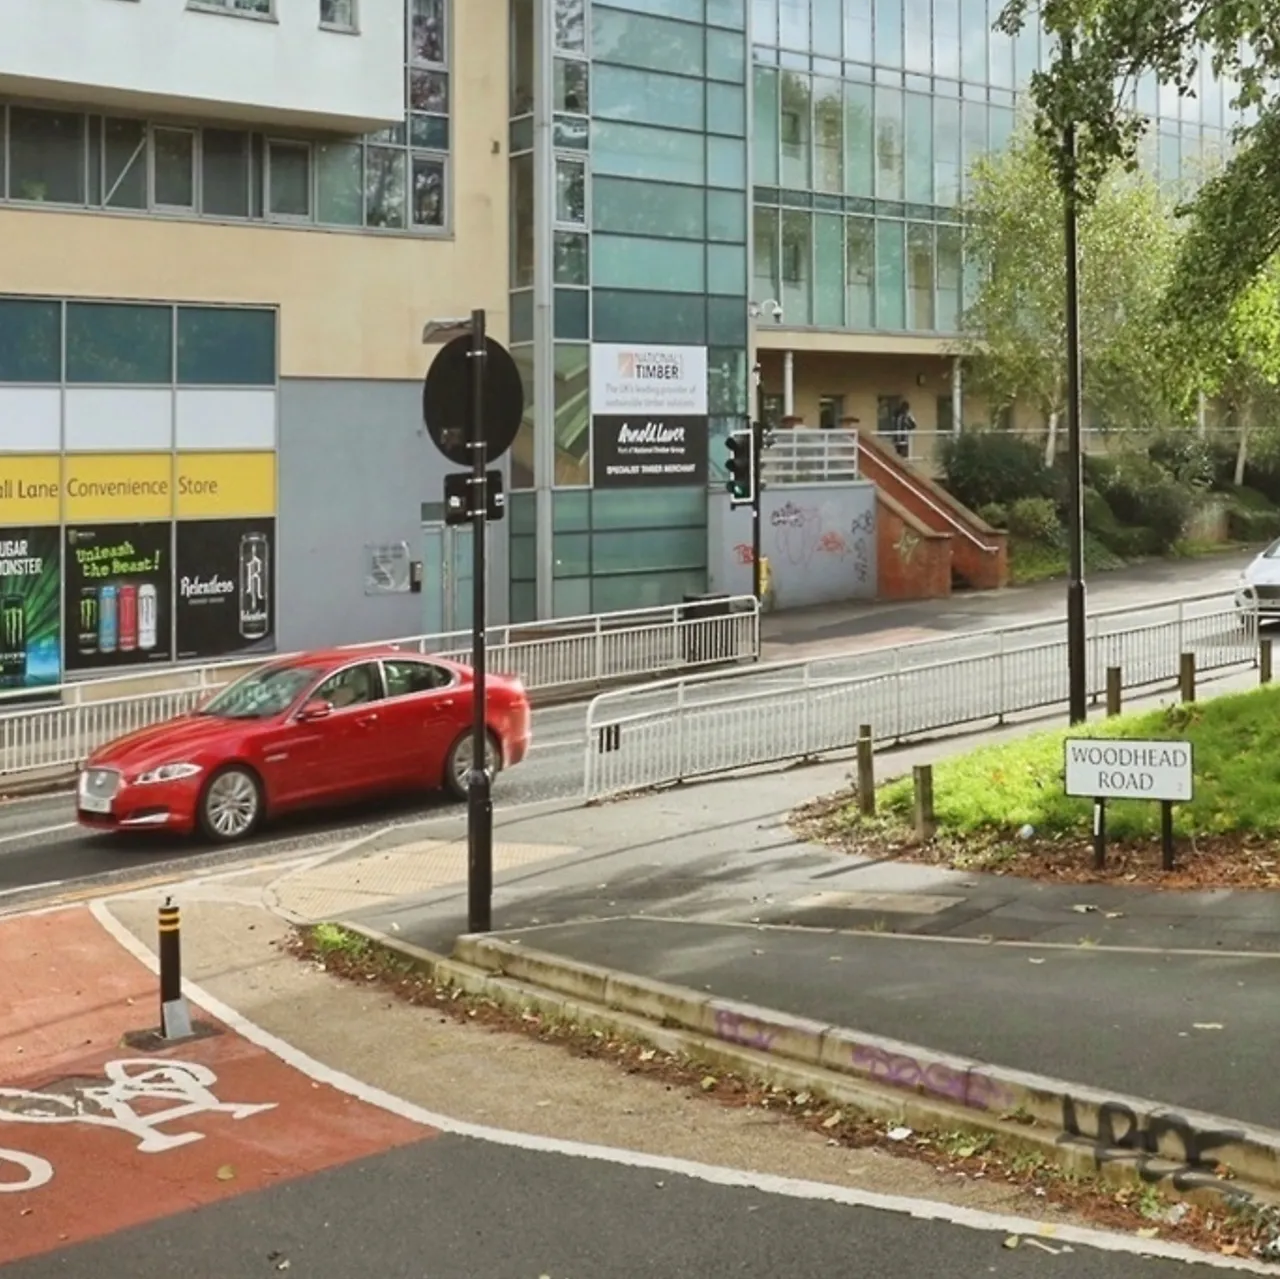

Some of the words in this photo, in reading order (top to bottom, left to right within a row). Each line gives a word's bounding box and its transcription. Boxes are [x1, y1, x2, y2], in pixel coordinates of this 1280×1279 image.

[635, 364, 680, 380] TIMBER
[18, 480, 59, 499] Lane
[66, 477, 168, 498] Convenience
[178, 476, 218, 496] Store
[75, 540, 136, 564] Unleash
[82, 561, 110, 578] the
[180, 574, 235, 599] Relentless
[1071, 746, 1188, 768] WOODHEAD
[1098, 771, 1154, 791] ROAD
